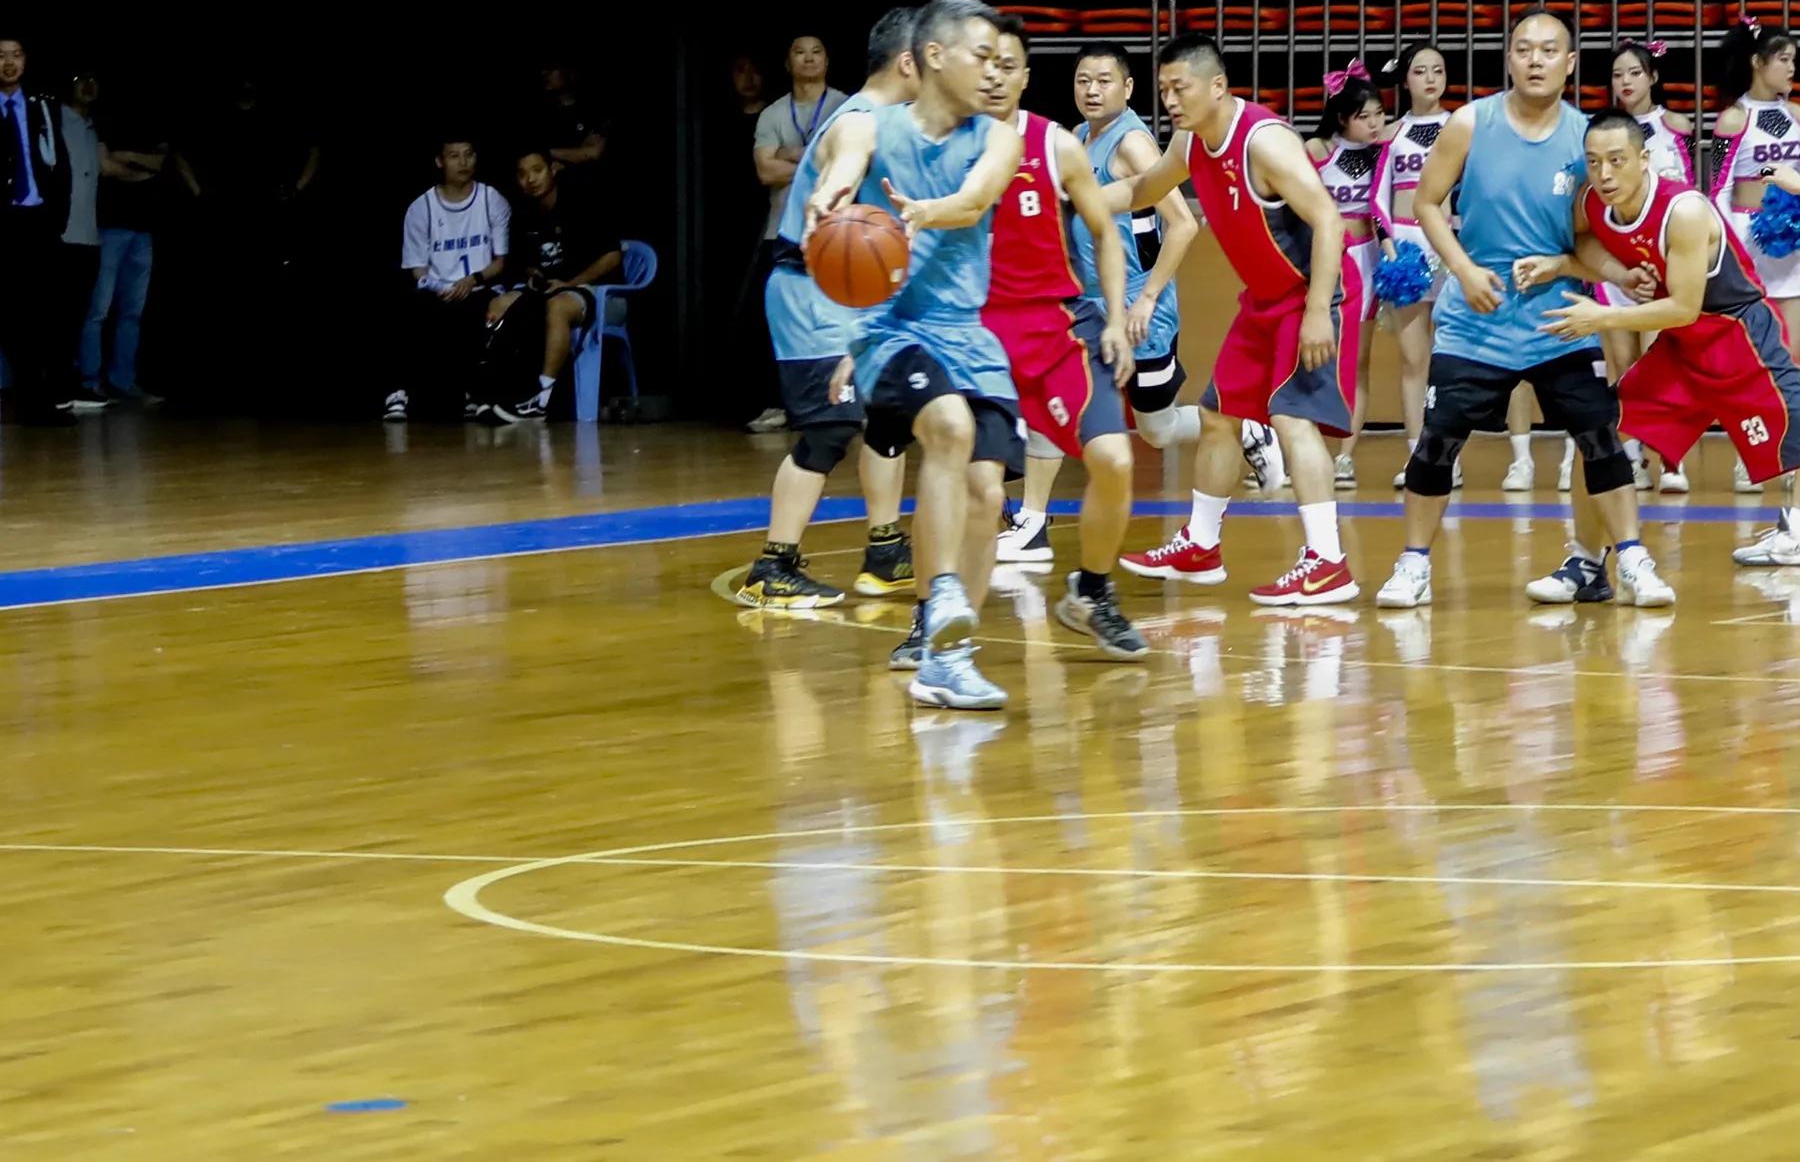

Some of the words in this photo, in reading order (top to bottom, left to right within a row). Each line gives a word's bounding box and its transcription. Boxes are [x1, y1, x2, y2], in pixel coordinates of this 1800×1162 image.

[1018, 189, 1042, 218] 8
[459, 253, 472, 277] 1
[1047, 395, 1071, 428] 8
[1739, 414, 1771, 447] 33
